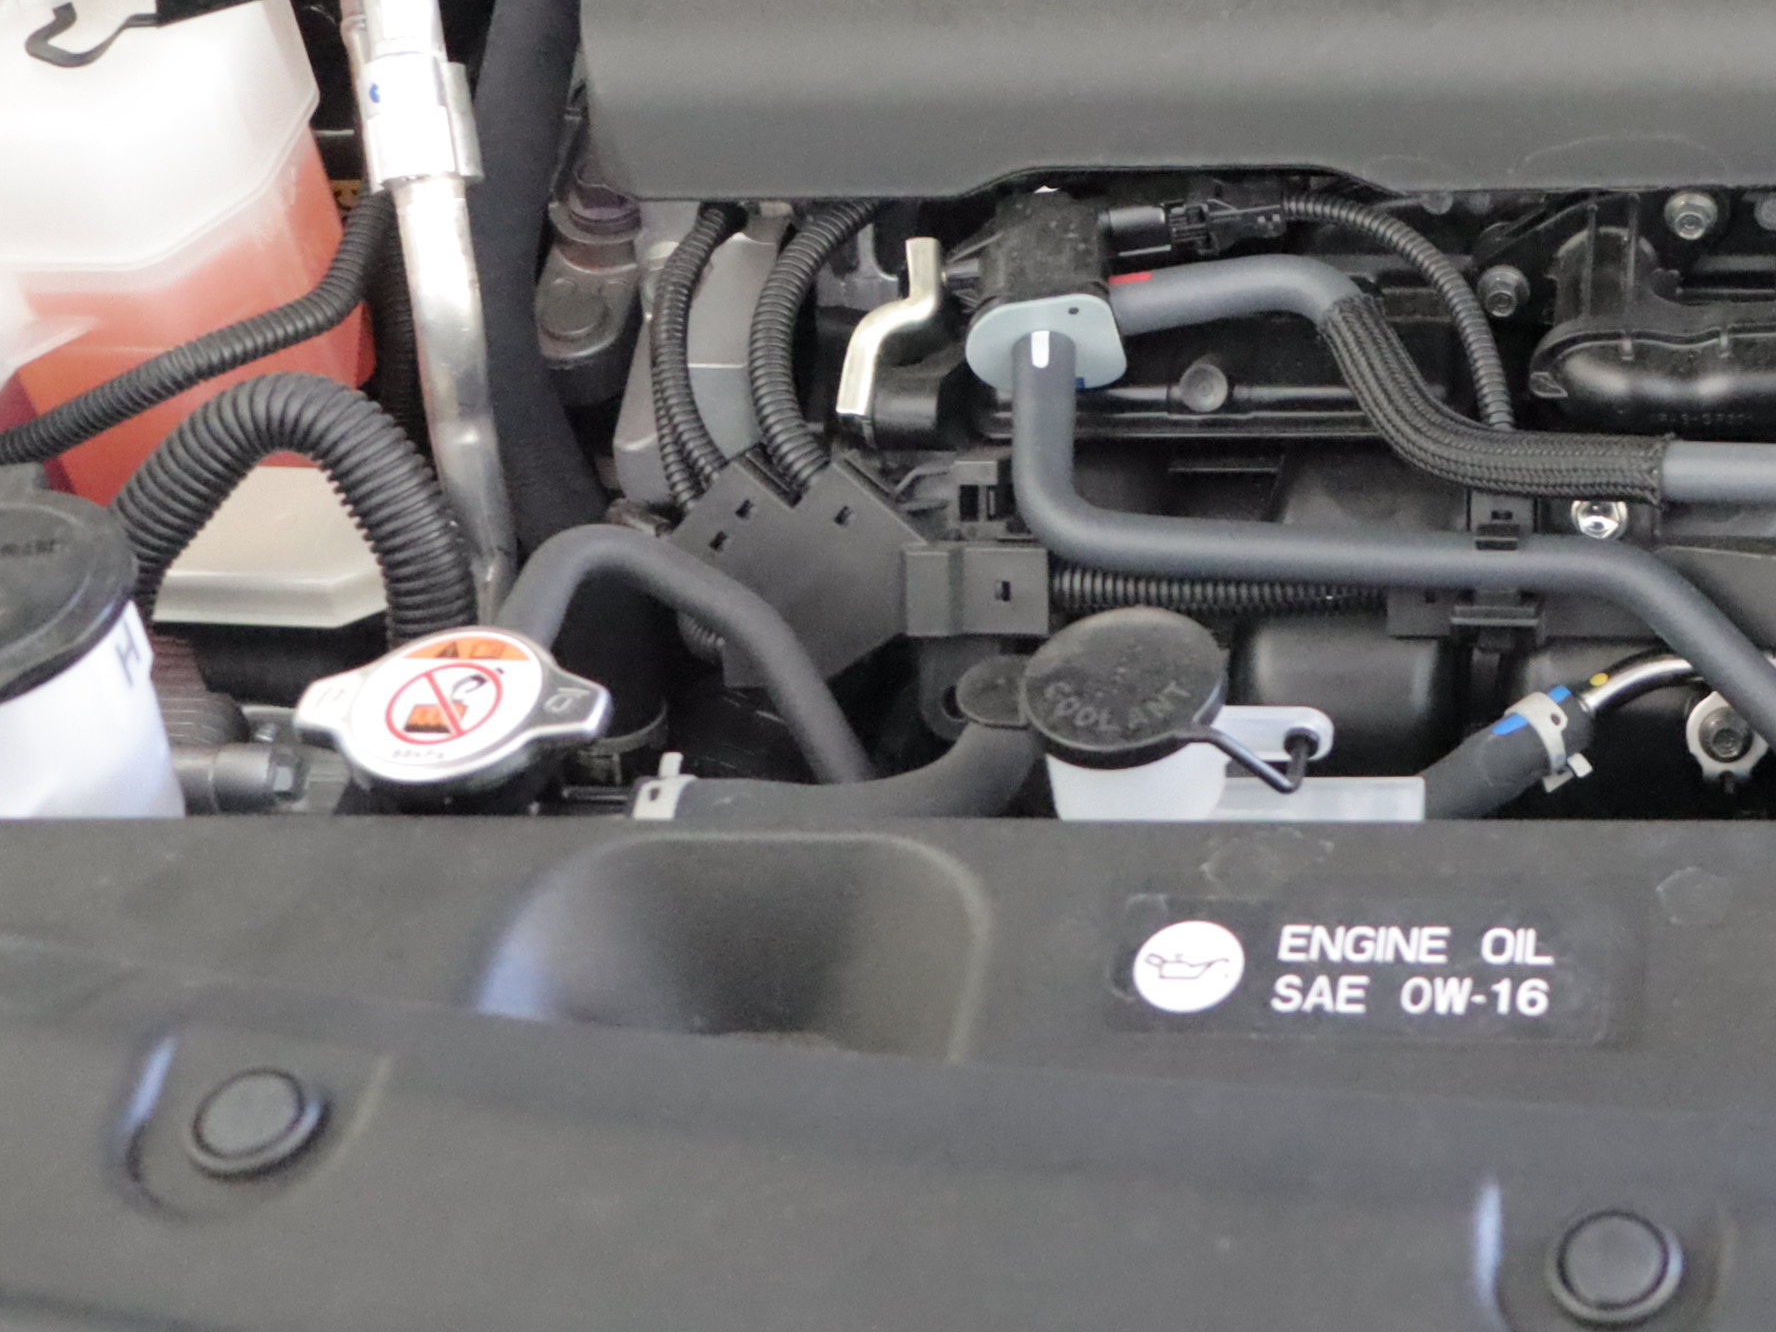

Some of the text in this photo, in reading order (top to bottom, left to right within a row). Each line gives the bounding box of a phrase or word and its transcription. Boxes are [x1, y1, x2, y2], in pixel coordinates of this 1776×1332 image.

[1043, 680, 1192, 735] COOLANT
[1277, 924, 1555, 966] ENGINE OIL
[1270, 973, 1550, 1017] SAE 0W-16
